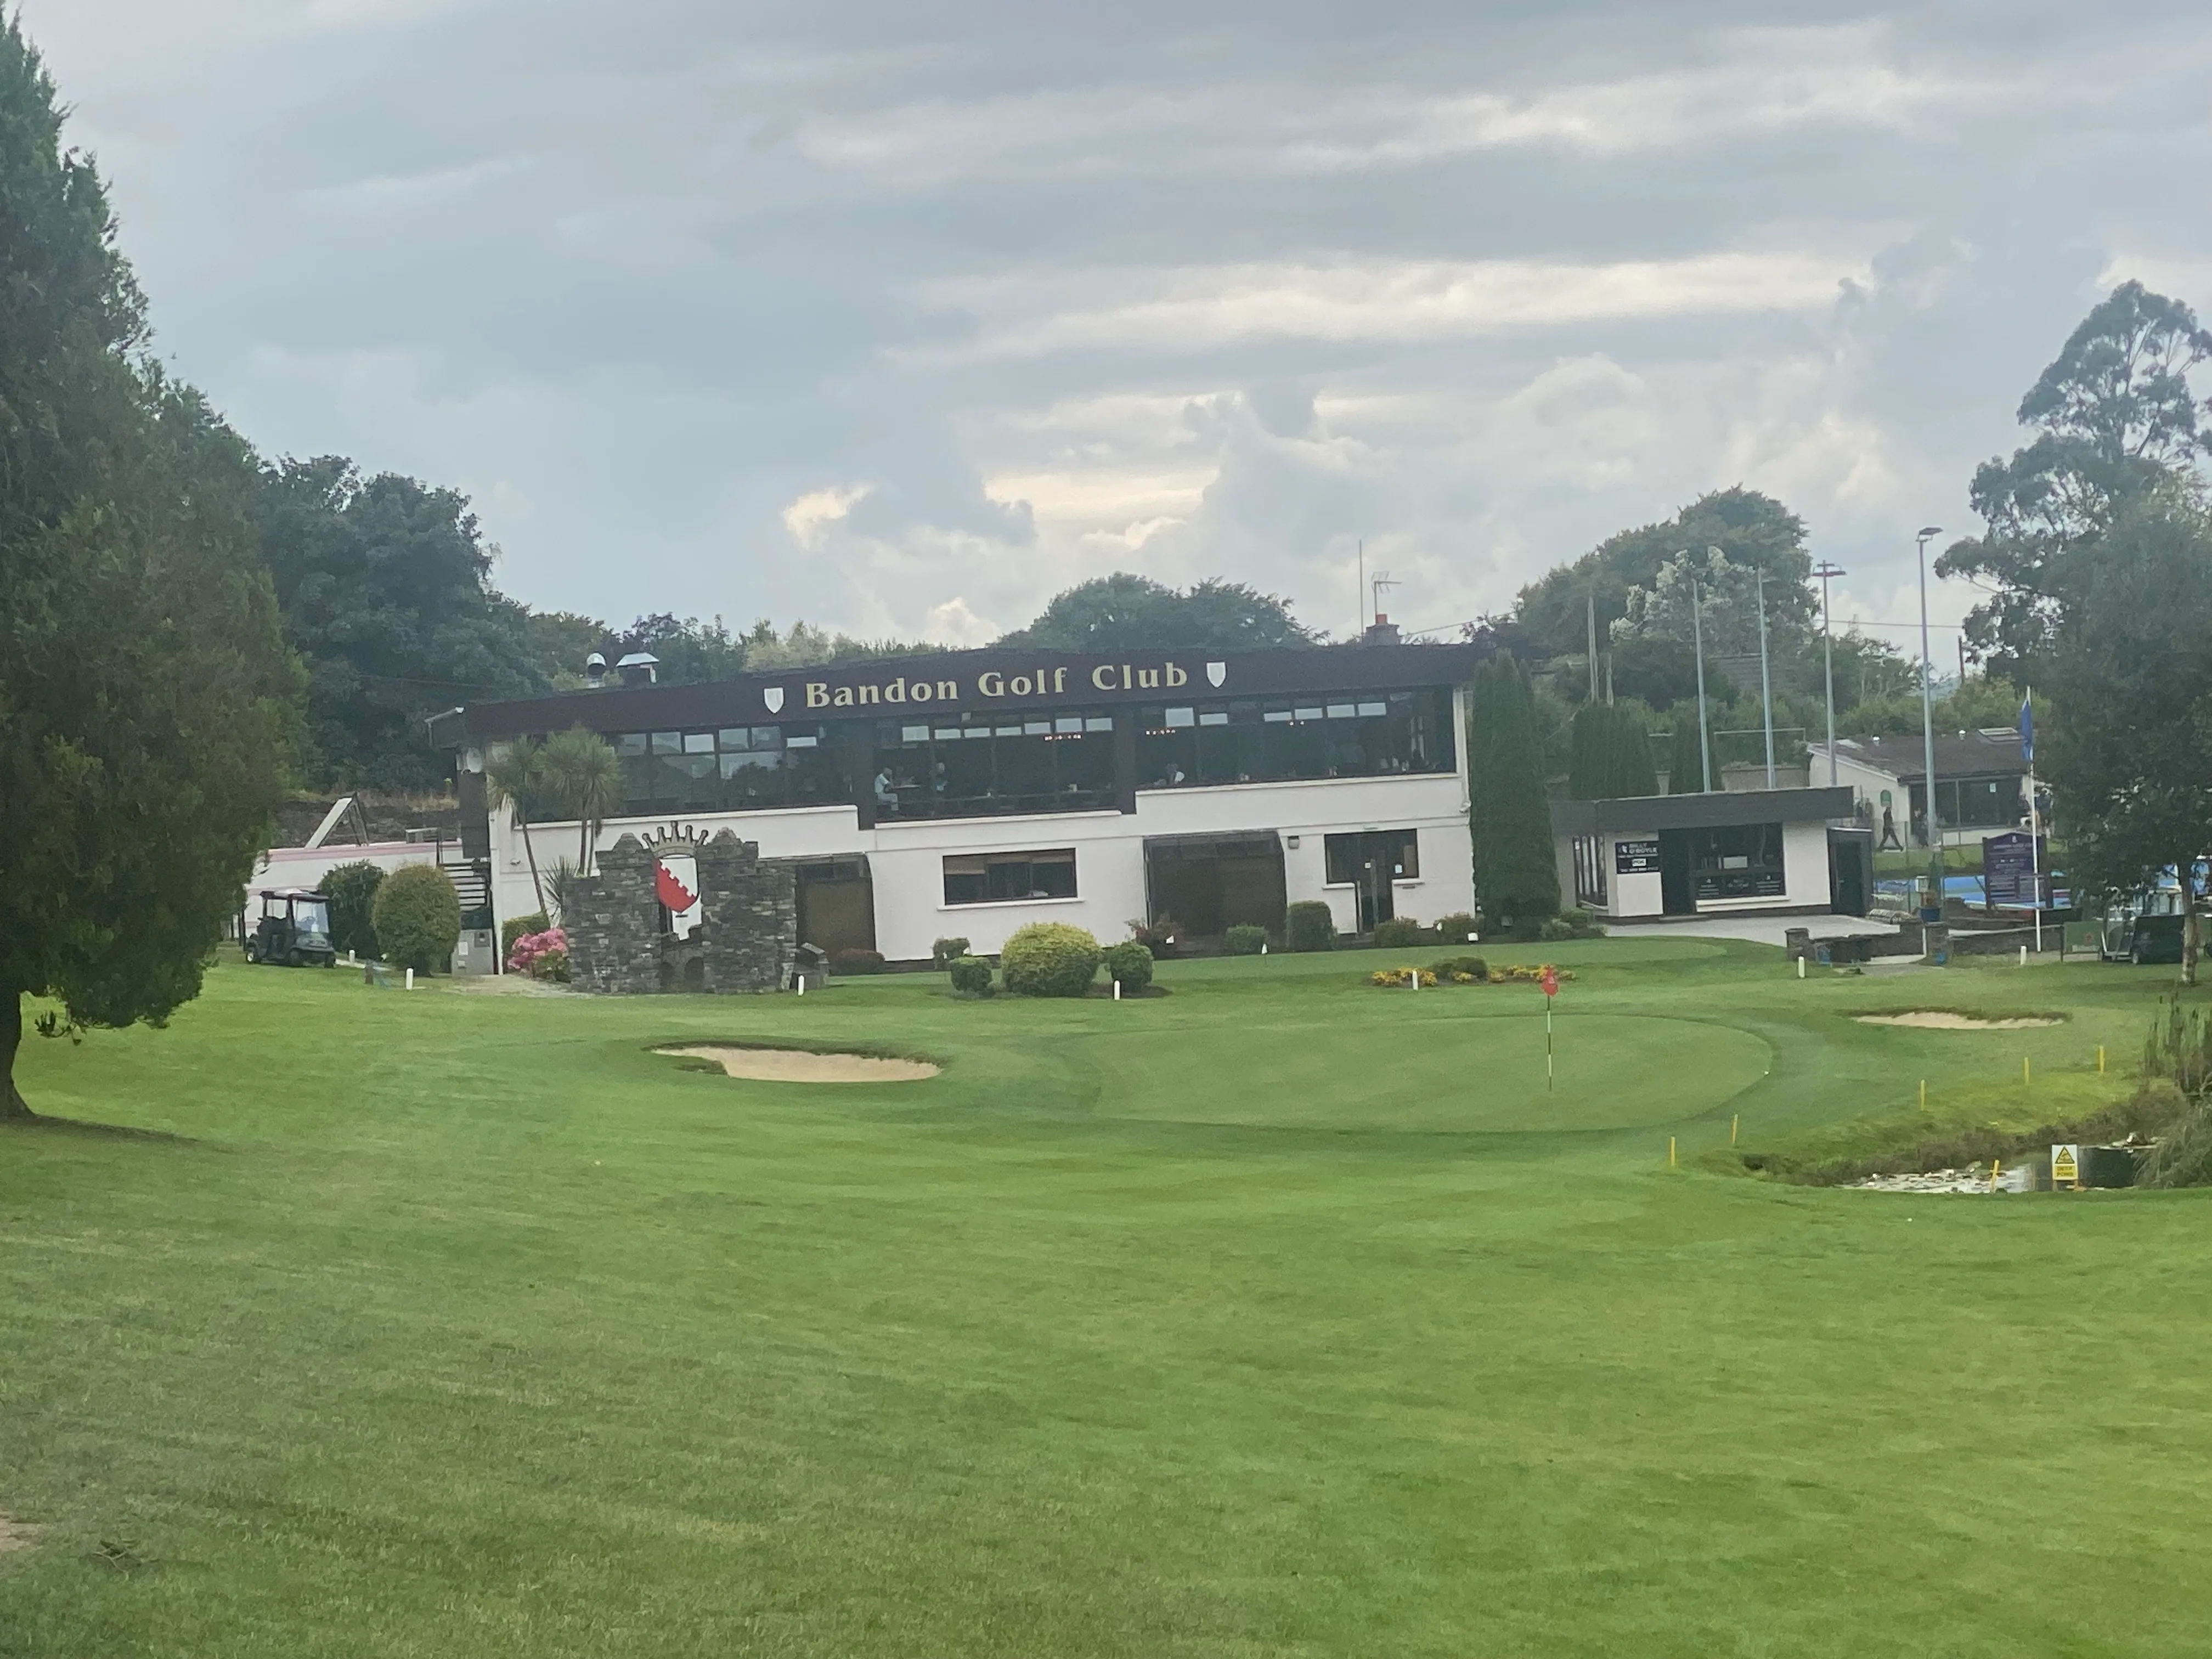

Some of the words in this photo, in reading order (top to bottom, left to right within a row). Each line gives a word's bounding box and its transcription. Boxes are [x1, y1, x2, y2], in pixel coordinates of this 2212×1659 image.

[806, 677, 958, 708] Bandon
[978, 667, 1068, 697] Golf
[1092, 662, 1187, 690] Club
